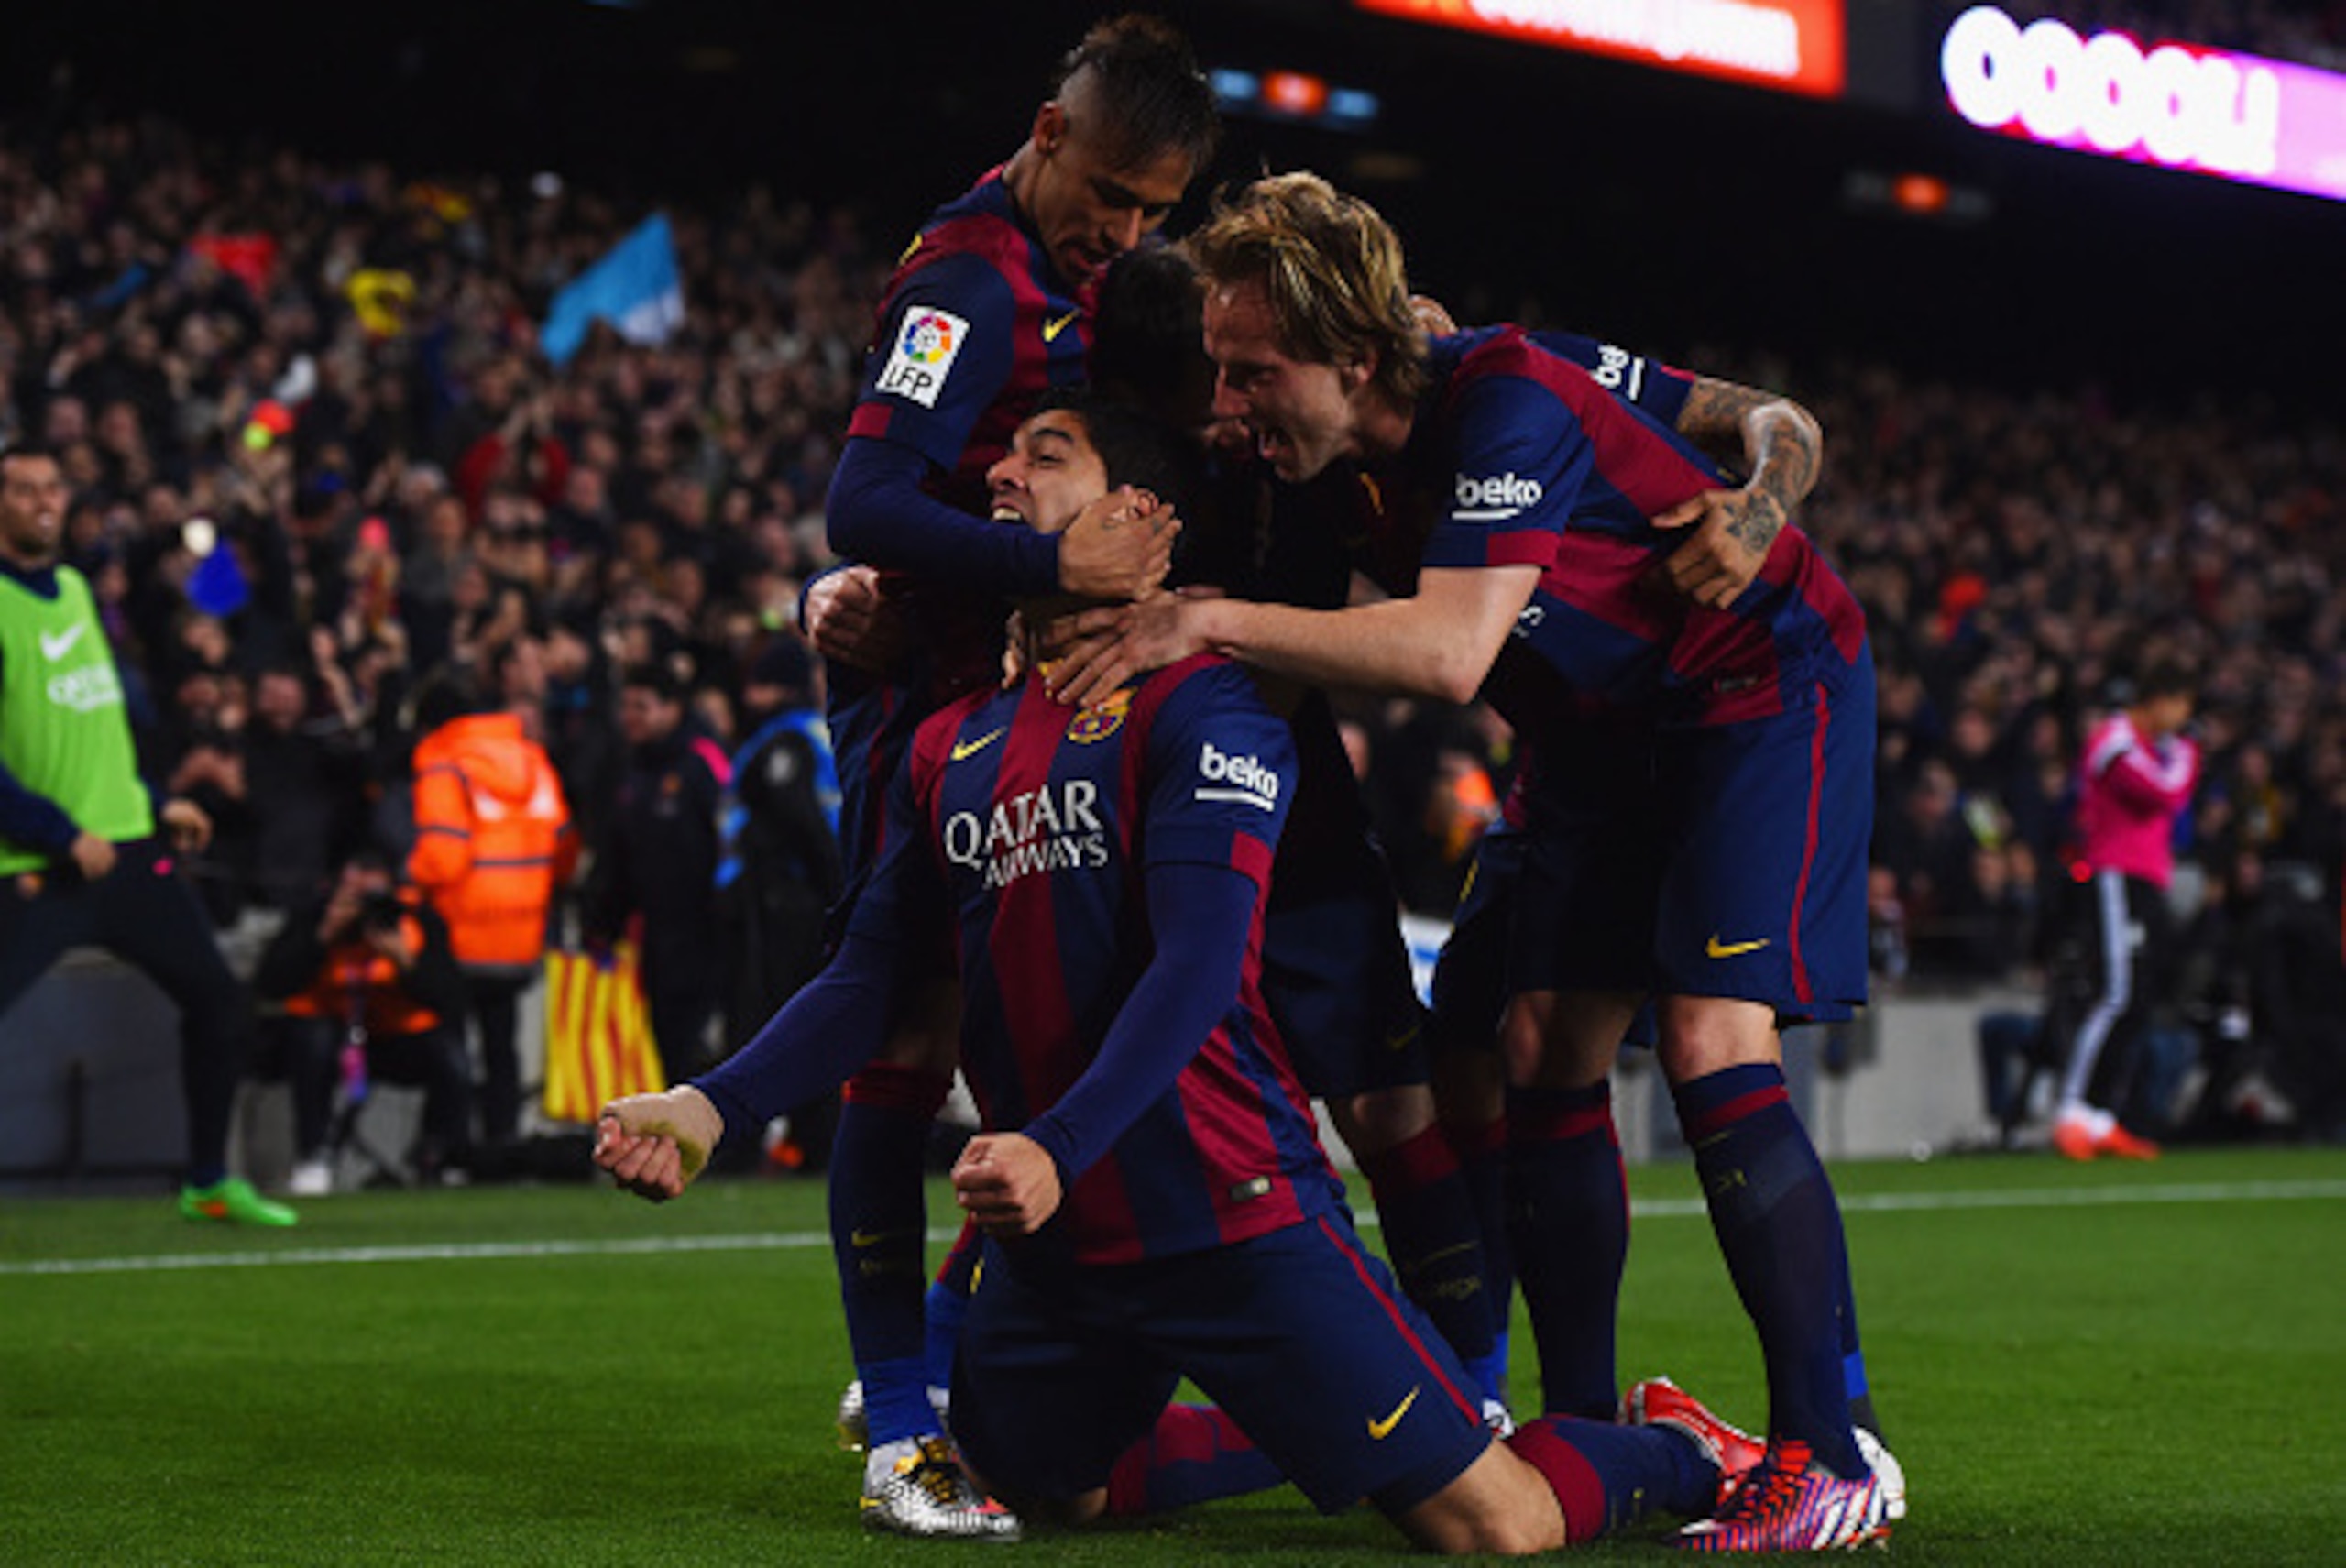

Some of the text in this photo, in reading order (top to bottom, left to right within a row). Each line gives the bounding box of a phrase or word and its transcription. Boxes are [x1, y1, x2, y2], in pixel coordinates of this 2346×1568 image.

[886, 366, 933, 395] LFP
[1455, 471, 1542, 507] beko
[1200, 741, 1278, 799] beko
[945, 780, 1103, 871] QATAR
[982, 831, 1108, 890] AIRWAYS
